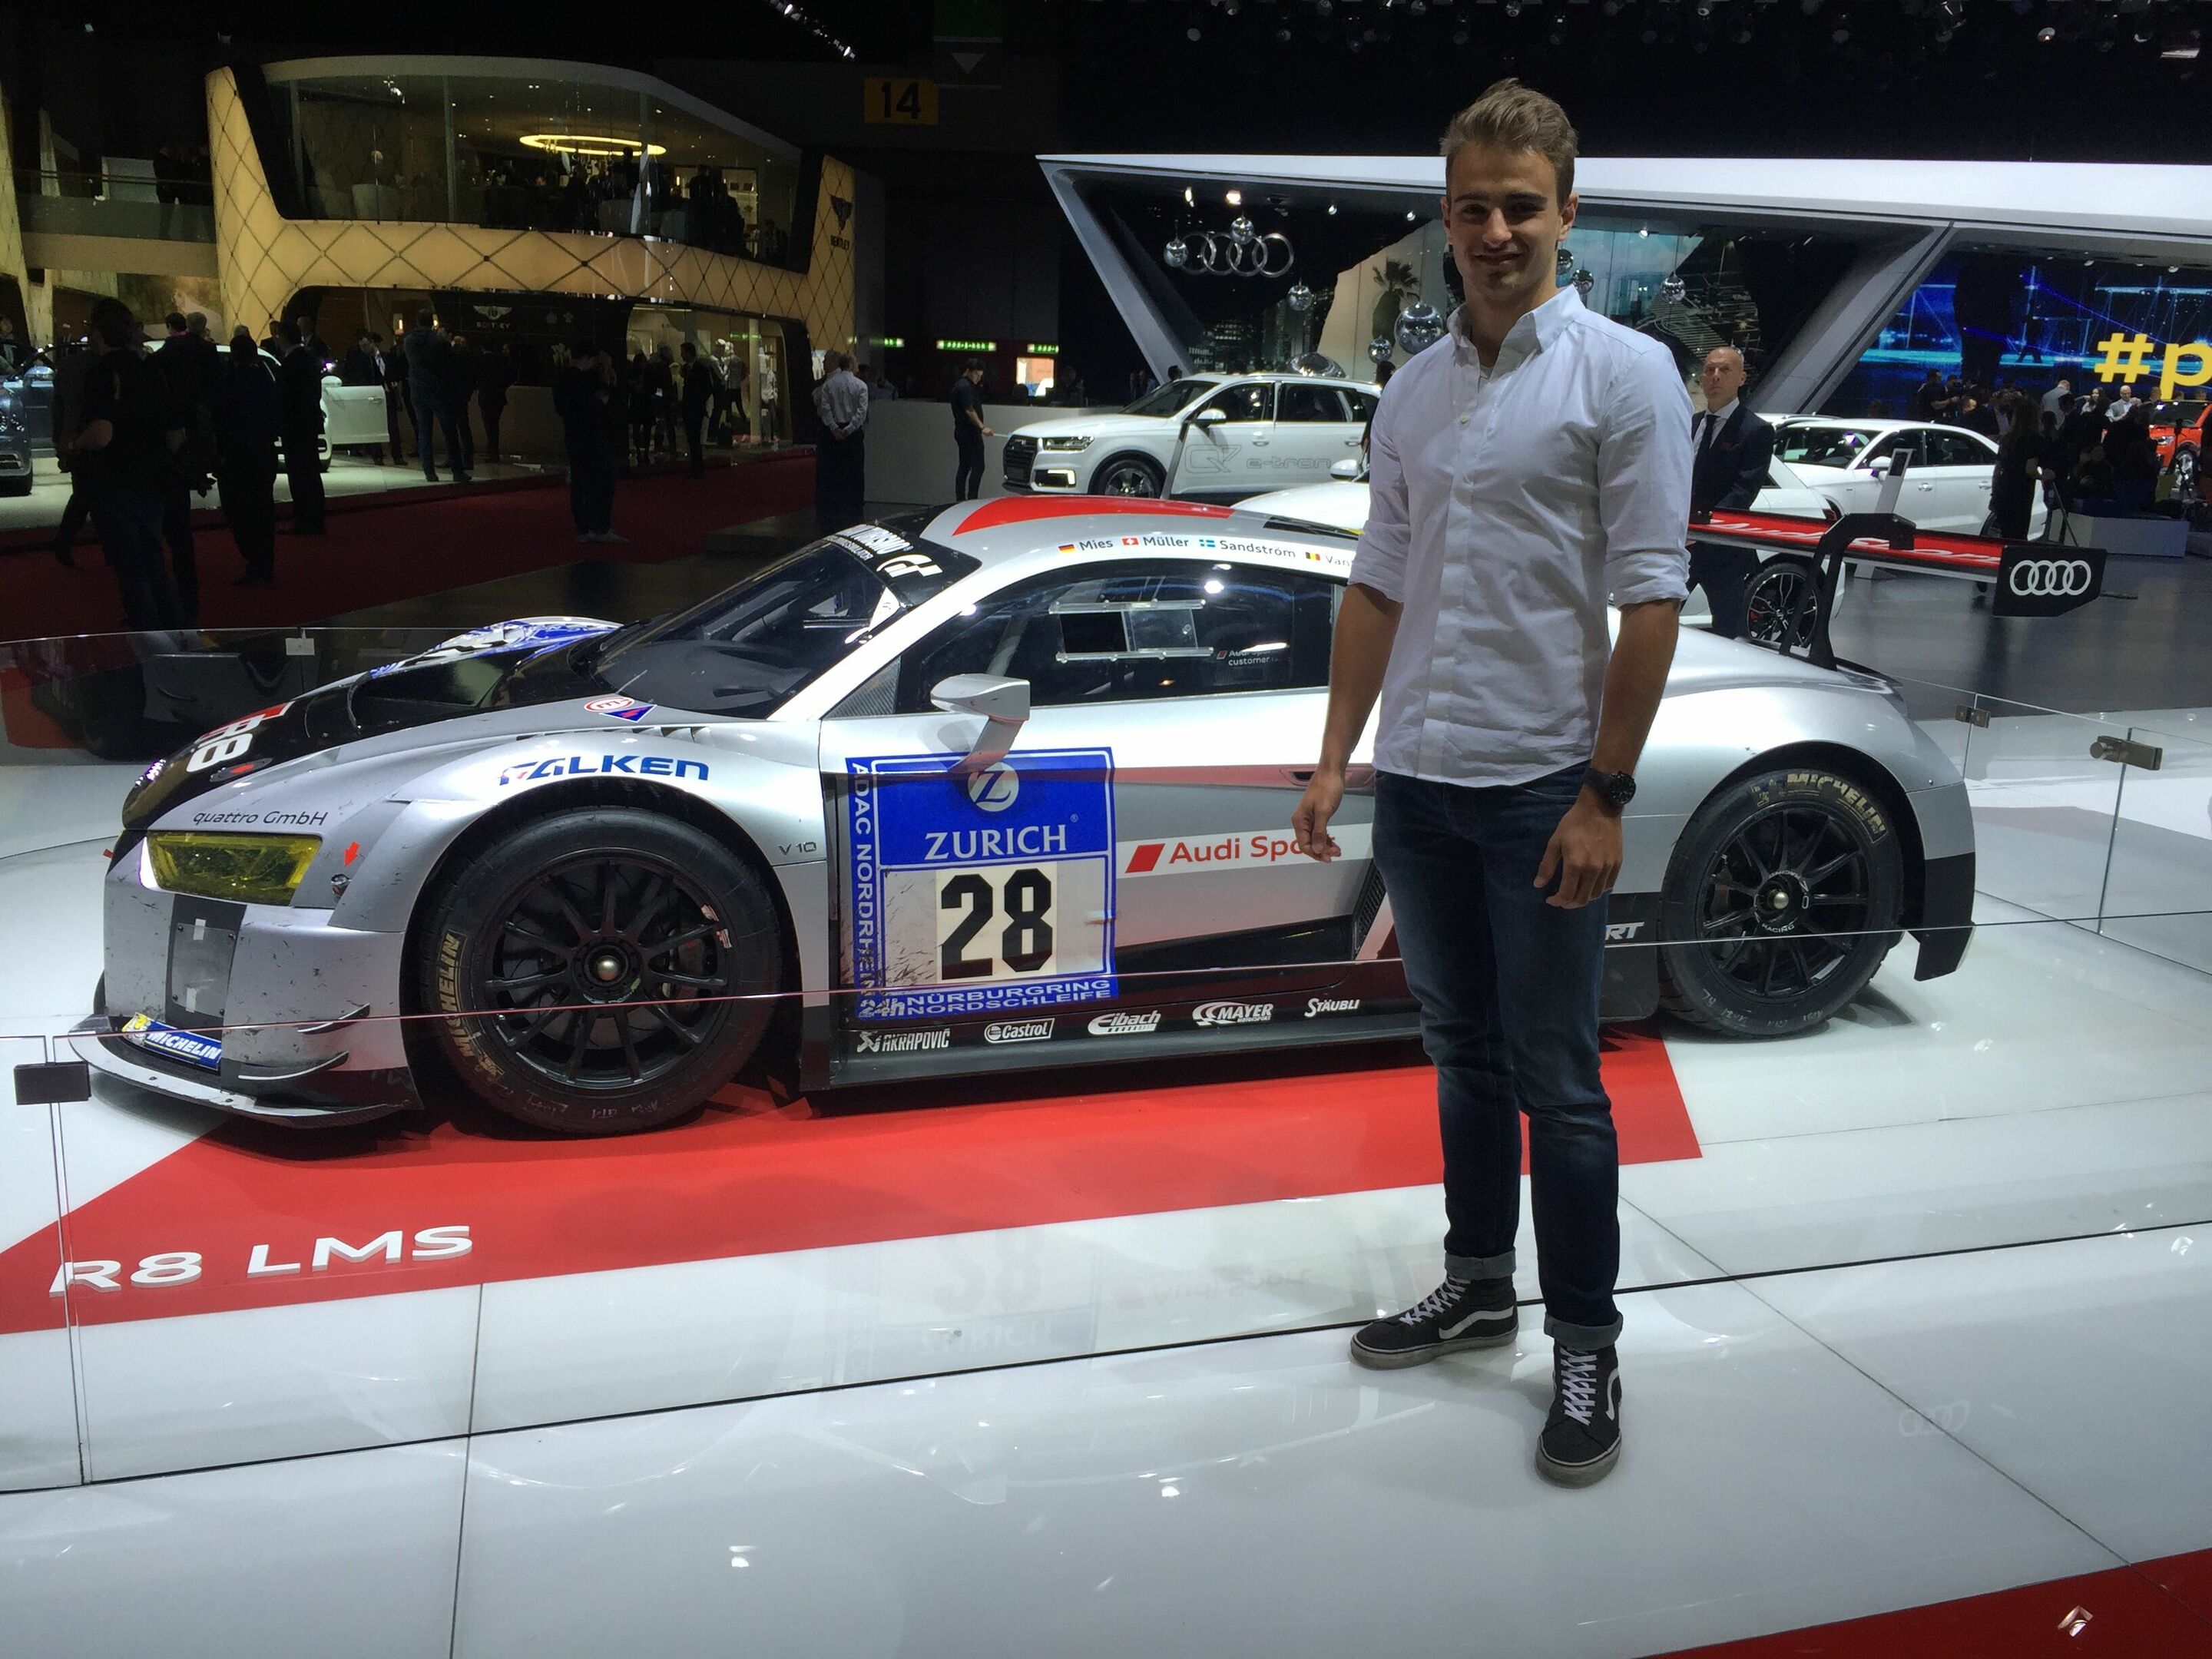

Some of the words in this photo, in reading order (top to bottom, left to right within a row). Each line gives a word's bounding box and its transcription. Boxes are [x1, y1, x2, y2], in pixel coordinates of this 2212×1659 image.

[881, 81, 922, 120] 14
[475, 320, 512, 329] BTEY
[1184, 444, 1243, 475] Q7
[1246, 455, 1331, 470] e-tron
[1079, 539, 1114, 551] Mies
[1144, 536, 1190, 548] Müller
[1325, 554, 1355, 567] Van
[1228, 657, 1270, 667] customer
[496, 754, 710, 786] FALKEN
[851, 762, 872, 836] ADAC
[193, 811, 259, 826] quattro
[262, 810, 329, 826] GmbH
[923, 823, 1068, 861] ZURICH
[1168, 837, 1240, 865] Audi
[940, 867, 1053, 981] 28
[1604, 921, 1645, 941] RT
[438, 932, 475, 1058] MICHELIN
[906, 979, 1111, 1007] NÜRBURGRING
[907, 989, 1111, 1016] NORDSCHLEIFE
[1217, 1002, 1274, 1021] MAYER
[1304, 998, 1360, 1018] STÄUBLI
[1001, 1021, 1049, 1040] Castrol
[1088, 1010, 1161, 1035] Eibach
[146, 1031, 222, 1060] MICHELIN
[48, 1252, 202, 1298] R8
[247, 1224, 473, 1280] LMS
